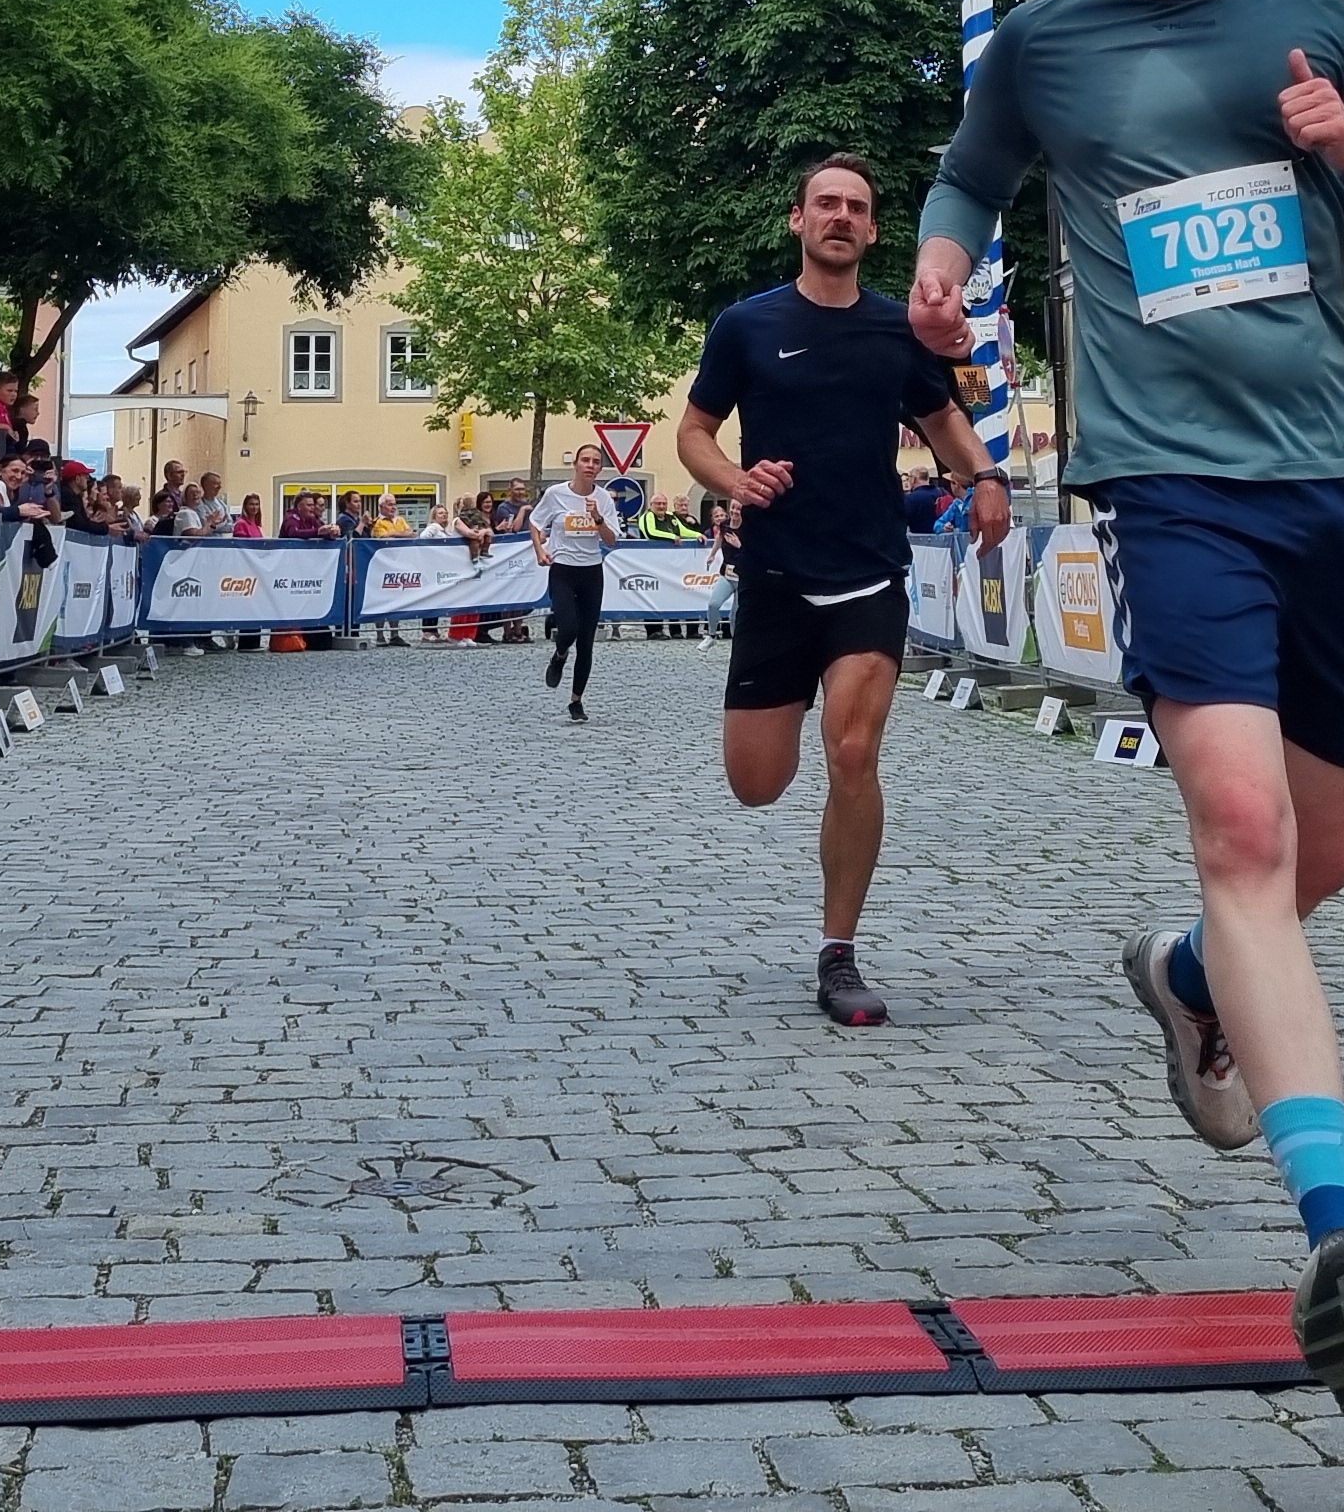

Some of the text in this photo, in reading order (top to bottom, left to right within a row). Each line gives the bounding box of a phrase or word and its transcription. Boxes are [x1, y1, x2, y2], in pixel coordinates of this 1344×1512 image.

[1151, 203, 1283, 269] 7028
[1191, 263, 1233, 278] Thomas
[570, 518, 596, 528] 4204
[1067, 572, 1098, 607] GLOBUS
